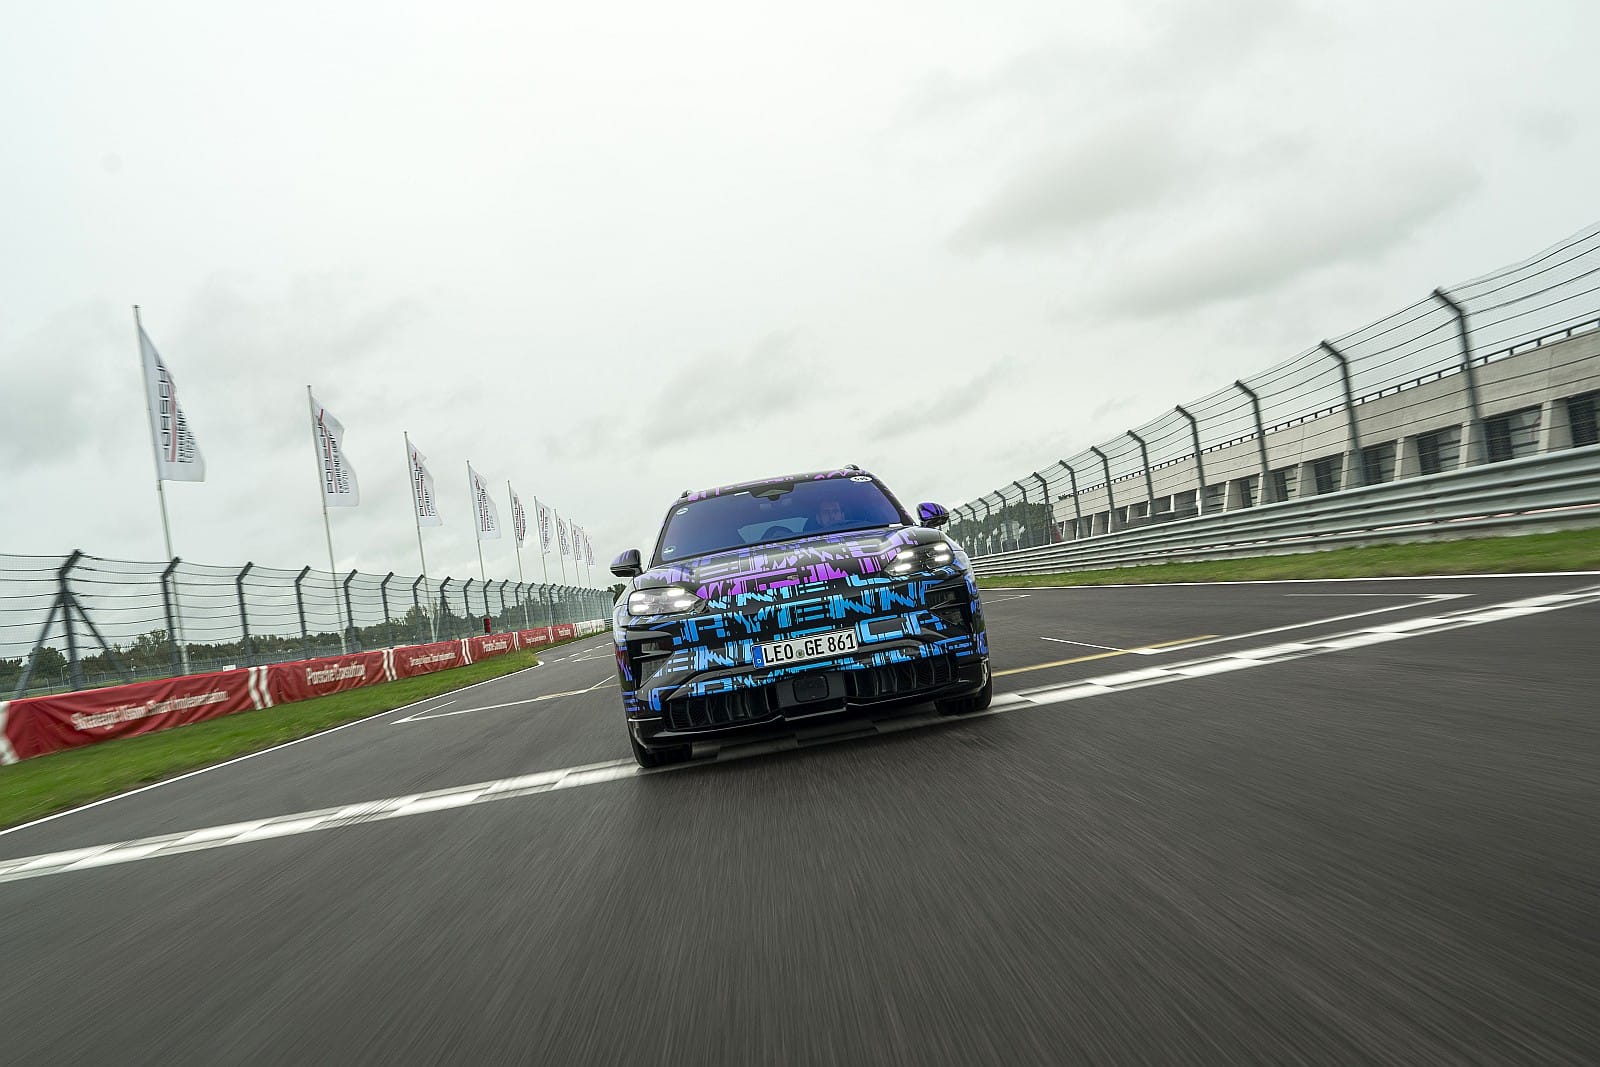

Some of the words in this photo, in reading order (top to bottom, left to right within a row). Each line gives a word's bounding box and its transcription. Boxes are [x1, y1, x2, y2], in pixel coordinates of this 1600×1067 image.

[764, 643, 794, 664] LEO
[805, 638, 824, 657] GE
[828, 633, 856, 653] 861
